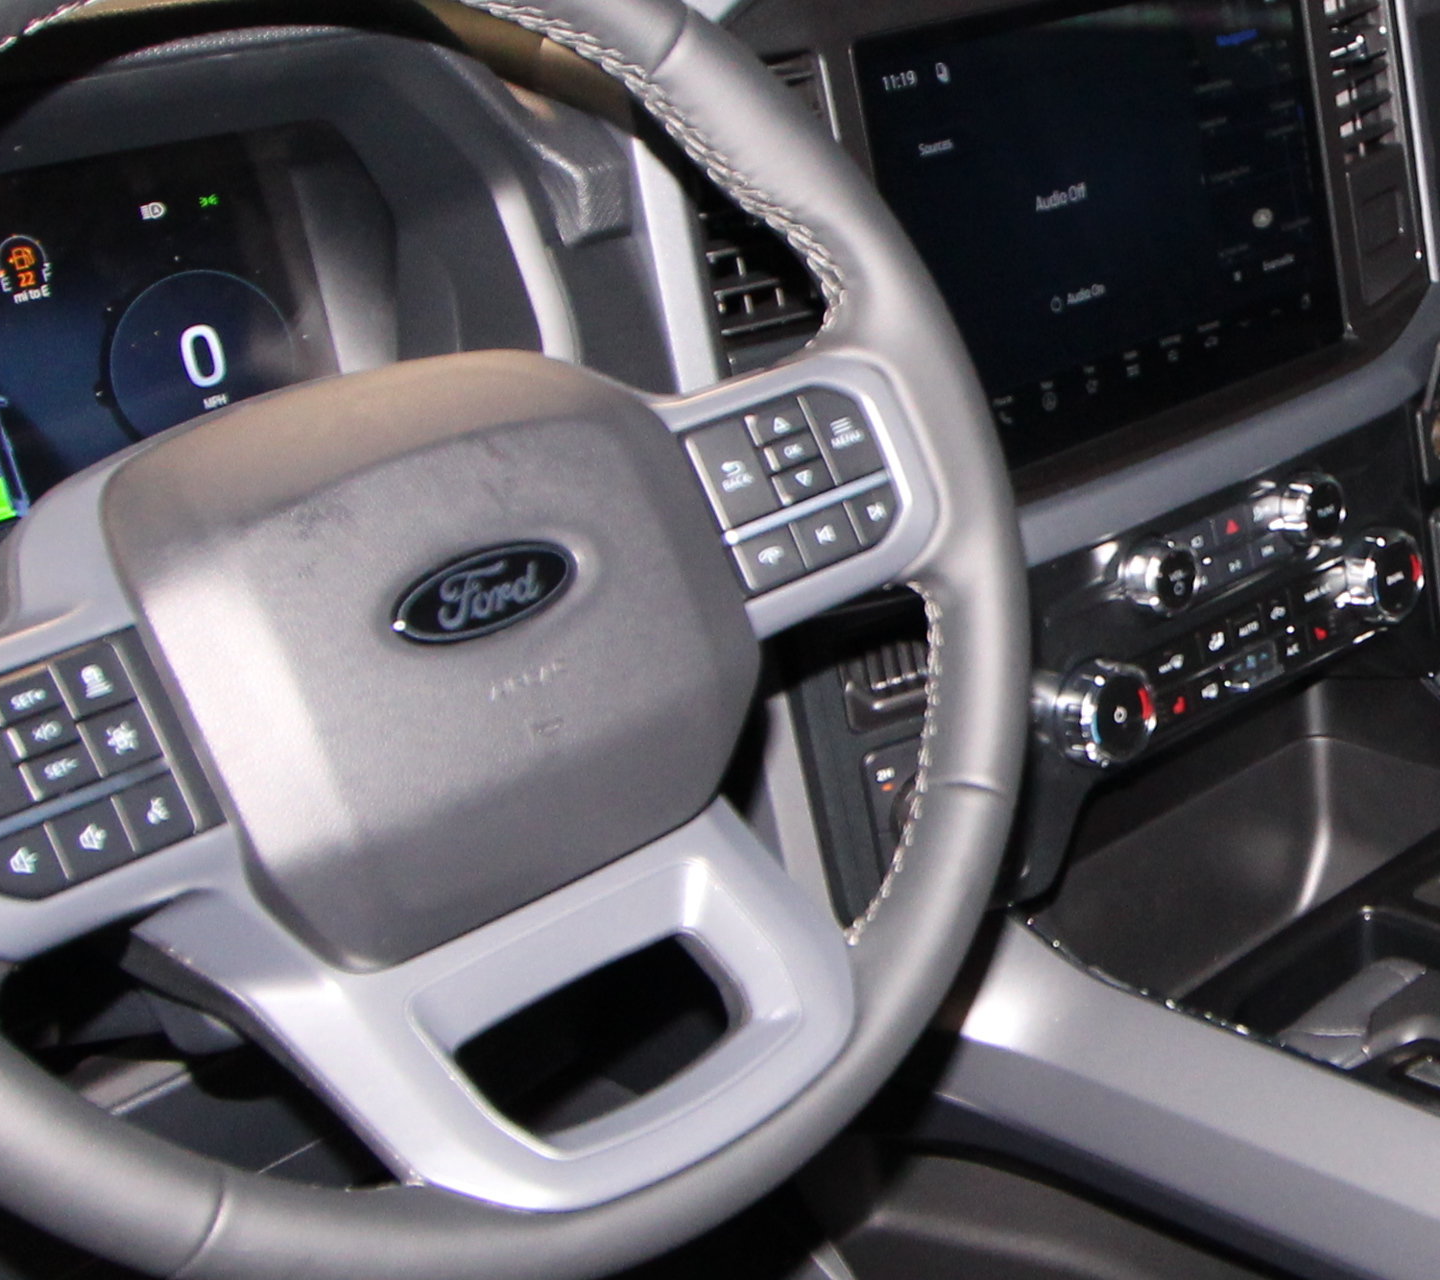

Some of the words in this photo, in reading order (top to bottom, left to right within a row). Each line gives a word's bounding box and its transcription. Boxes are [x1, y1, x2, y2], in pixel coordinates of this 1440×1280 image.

[881, 69, 918, 92] 11:19
[917, 138, 955, 158] Sources
[1035, 189, 1067, 212] Audio
[1067, 181, 1087, 202] Off
[0, 277, 13, 294] E
[17, 269, 36, 289] 22
[42, 267, 53, 284] F
[13, 290, 28, 304] mi
[28, 287, 41, 302] to
[40, 285, 52, 300] E
[1067, 288, 1091, 305] Audio
[1091, 282, 1106, 298] On
[178, 322, 228, 389] 0
[203, 392, 229, 410] MPH
[830, 429, 865, 450] MENU
[784, 442, 804, 460] OK
[722, 472, 755, 493] BACK
[437, 558, 546, 631] Ford
[1238, 619, 1260, 638] AUTO
